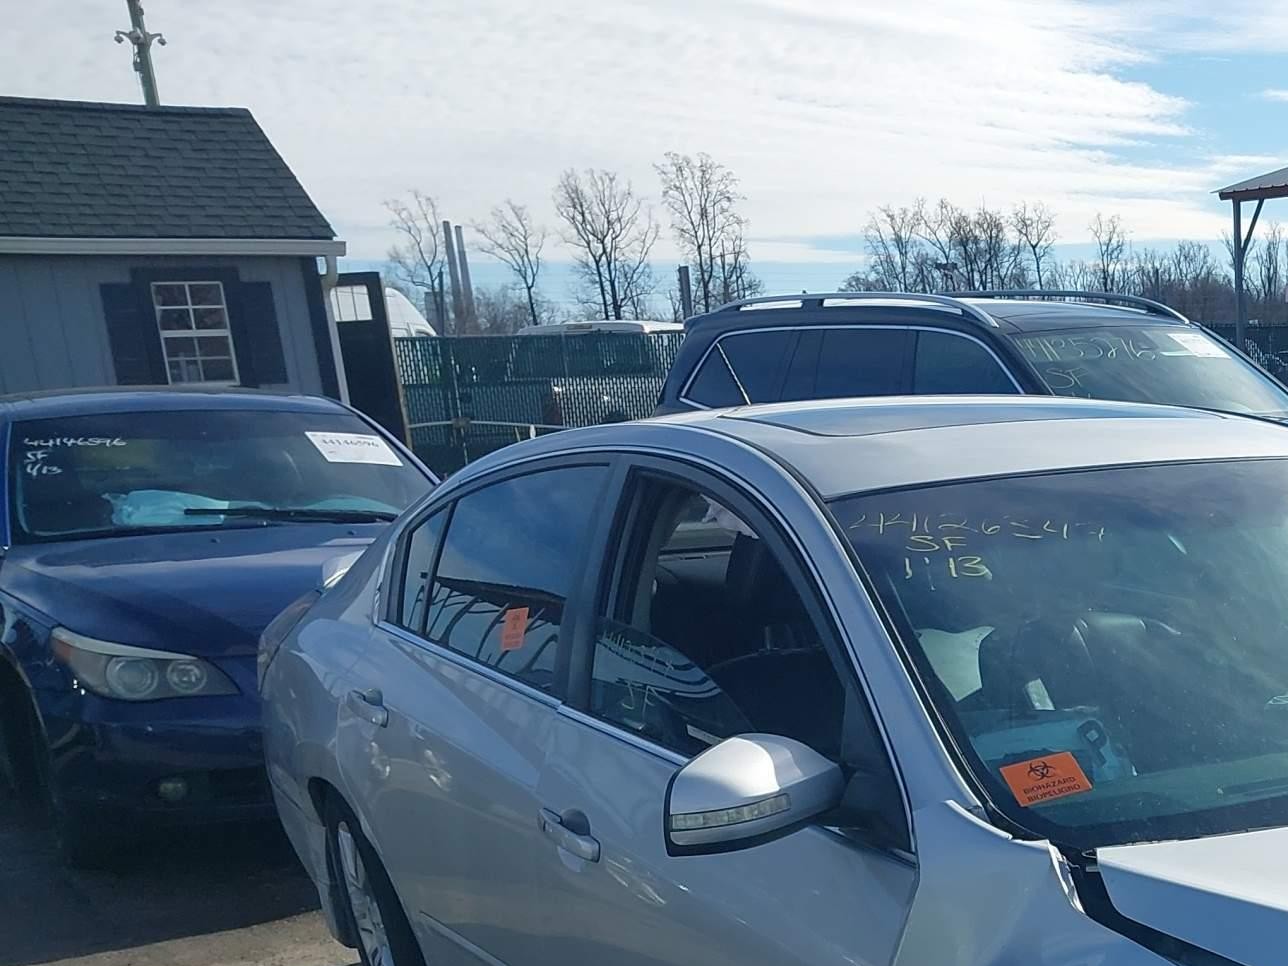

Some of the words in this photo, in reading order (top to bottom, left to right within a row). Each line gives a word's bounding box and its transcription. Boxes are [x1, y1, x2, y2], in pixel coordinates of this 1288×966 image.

[905, 535, 969, 552] SF
[1023, 776, 1077, 795] BIOHAZARD
[1026, 783, 1081, 802] BIOPELIGRO
